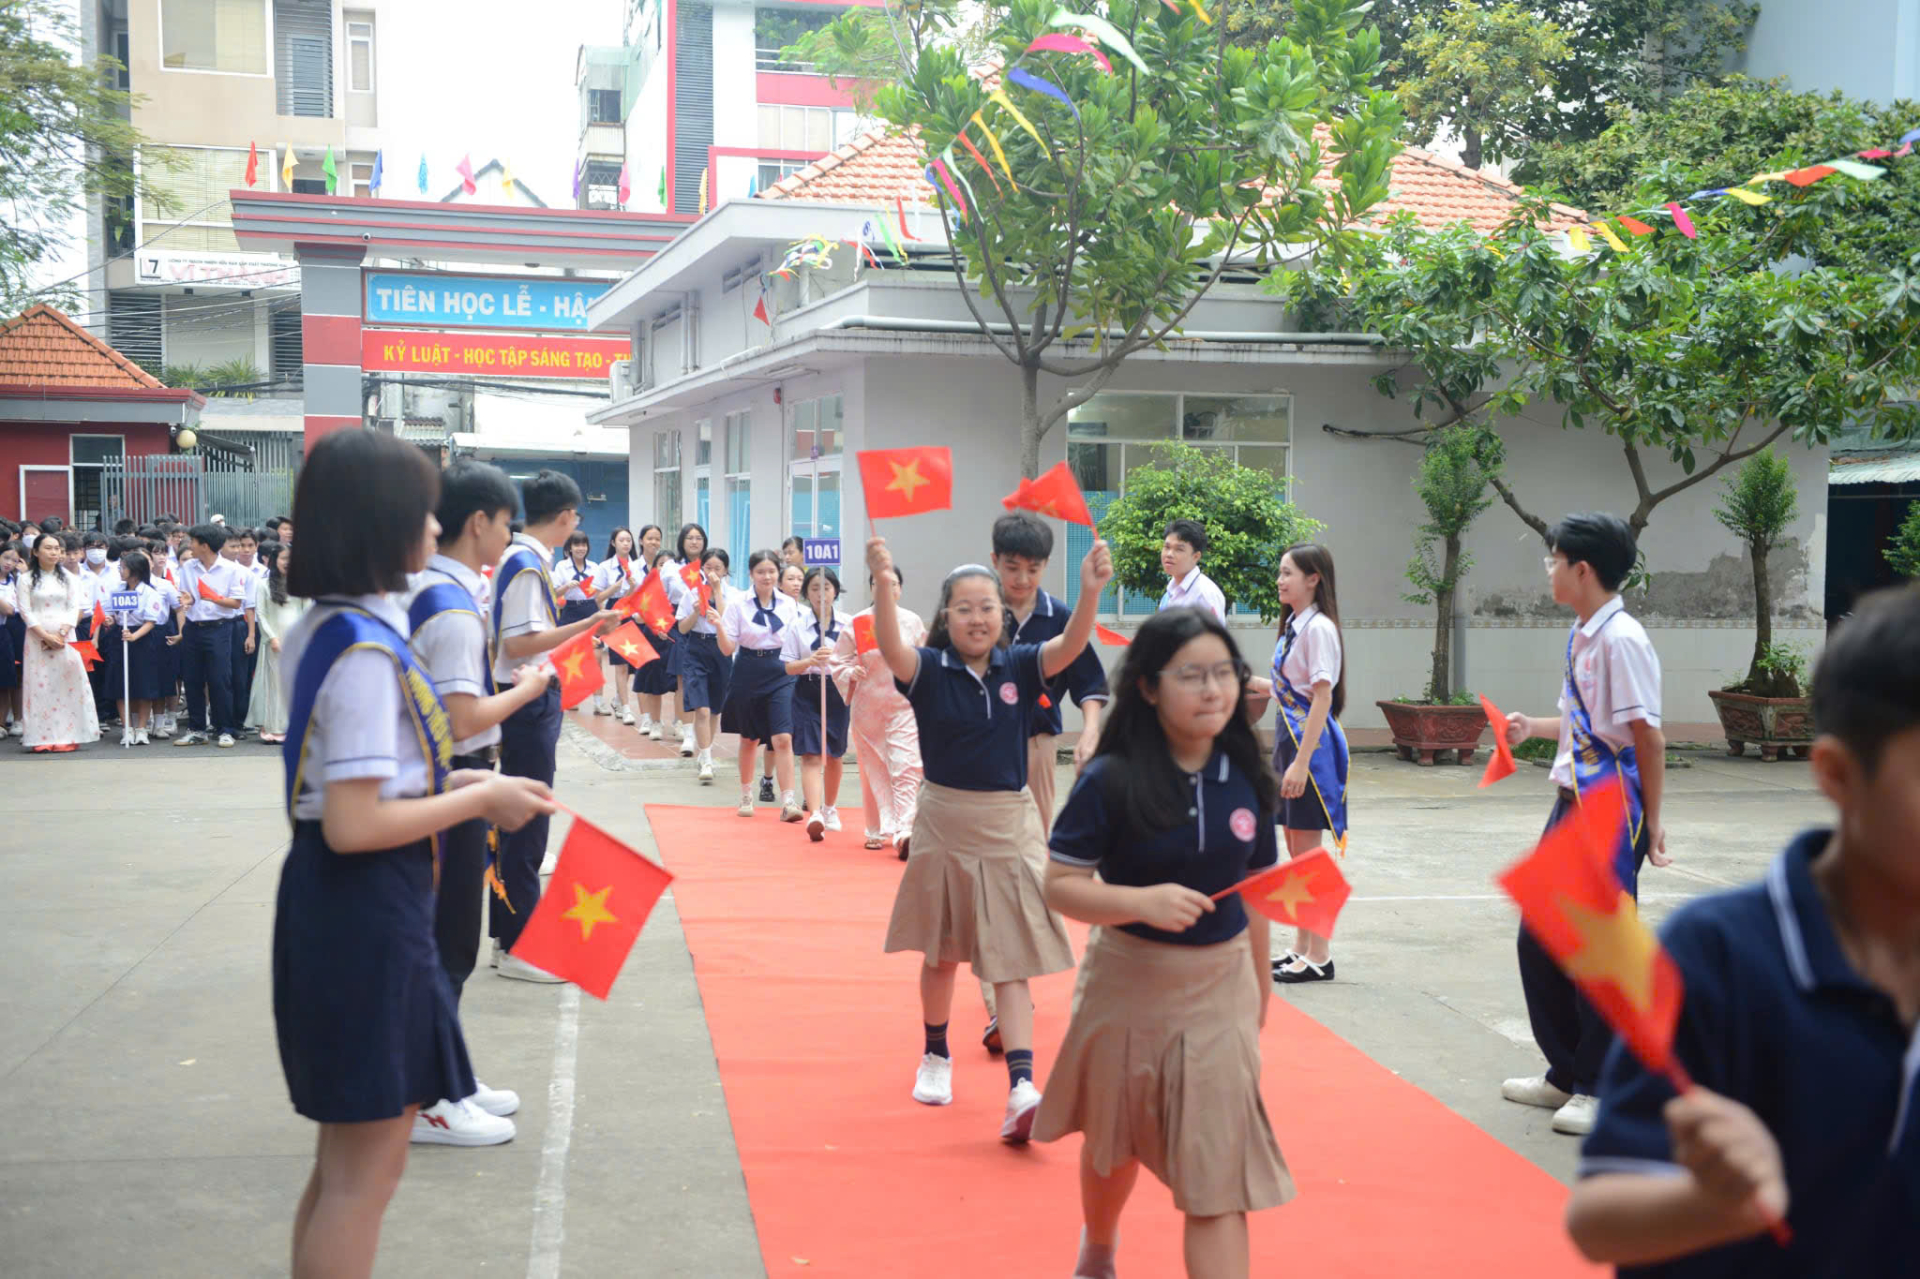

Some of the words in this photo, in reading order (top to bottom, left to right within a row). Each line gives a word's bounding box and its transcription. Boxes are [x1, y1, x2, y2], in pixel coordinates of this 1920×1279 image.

[376, 285, 435, 312] TIÊN
[444, 292, 495, 321] HỌC
[503, 285, 532, 316] LỄ
[554, 292, 595, 324] HẬ
[383, 338, 406, 361] KỶ
[411, 343, 451, 366] LUẬT
[464, 347, 496, 367] HỌC
[499, 346, 528, 368] TẬP
[530, 346, 571, 367] SÁNG
[574, 352, 603, 371] TẠO
[806, 544, 839, 559] 10A1
[112, 596, 137, 606] 10A3
